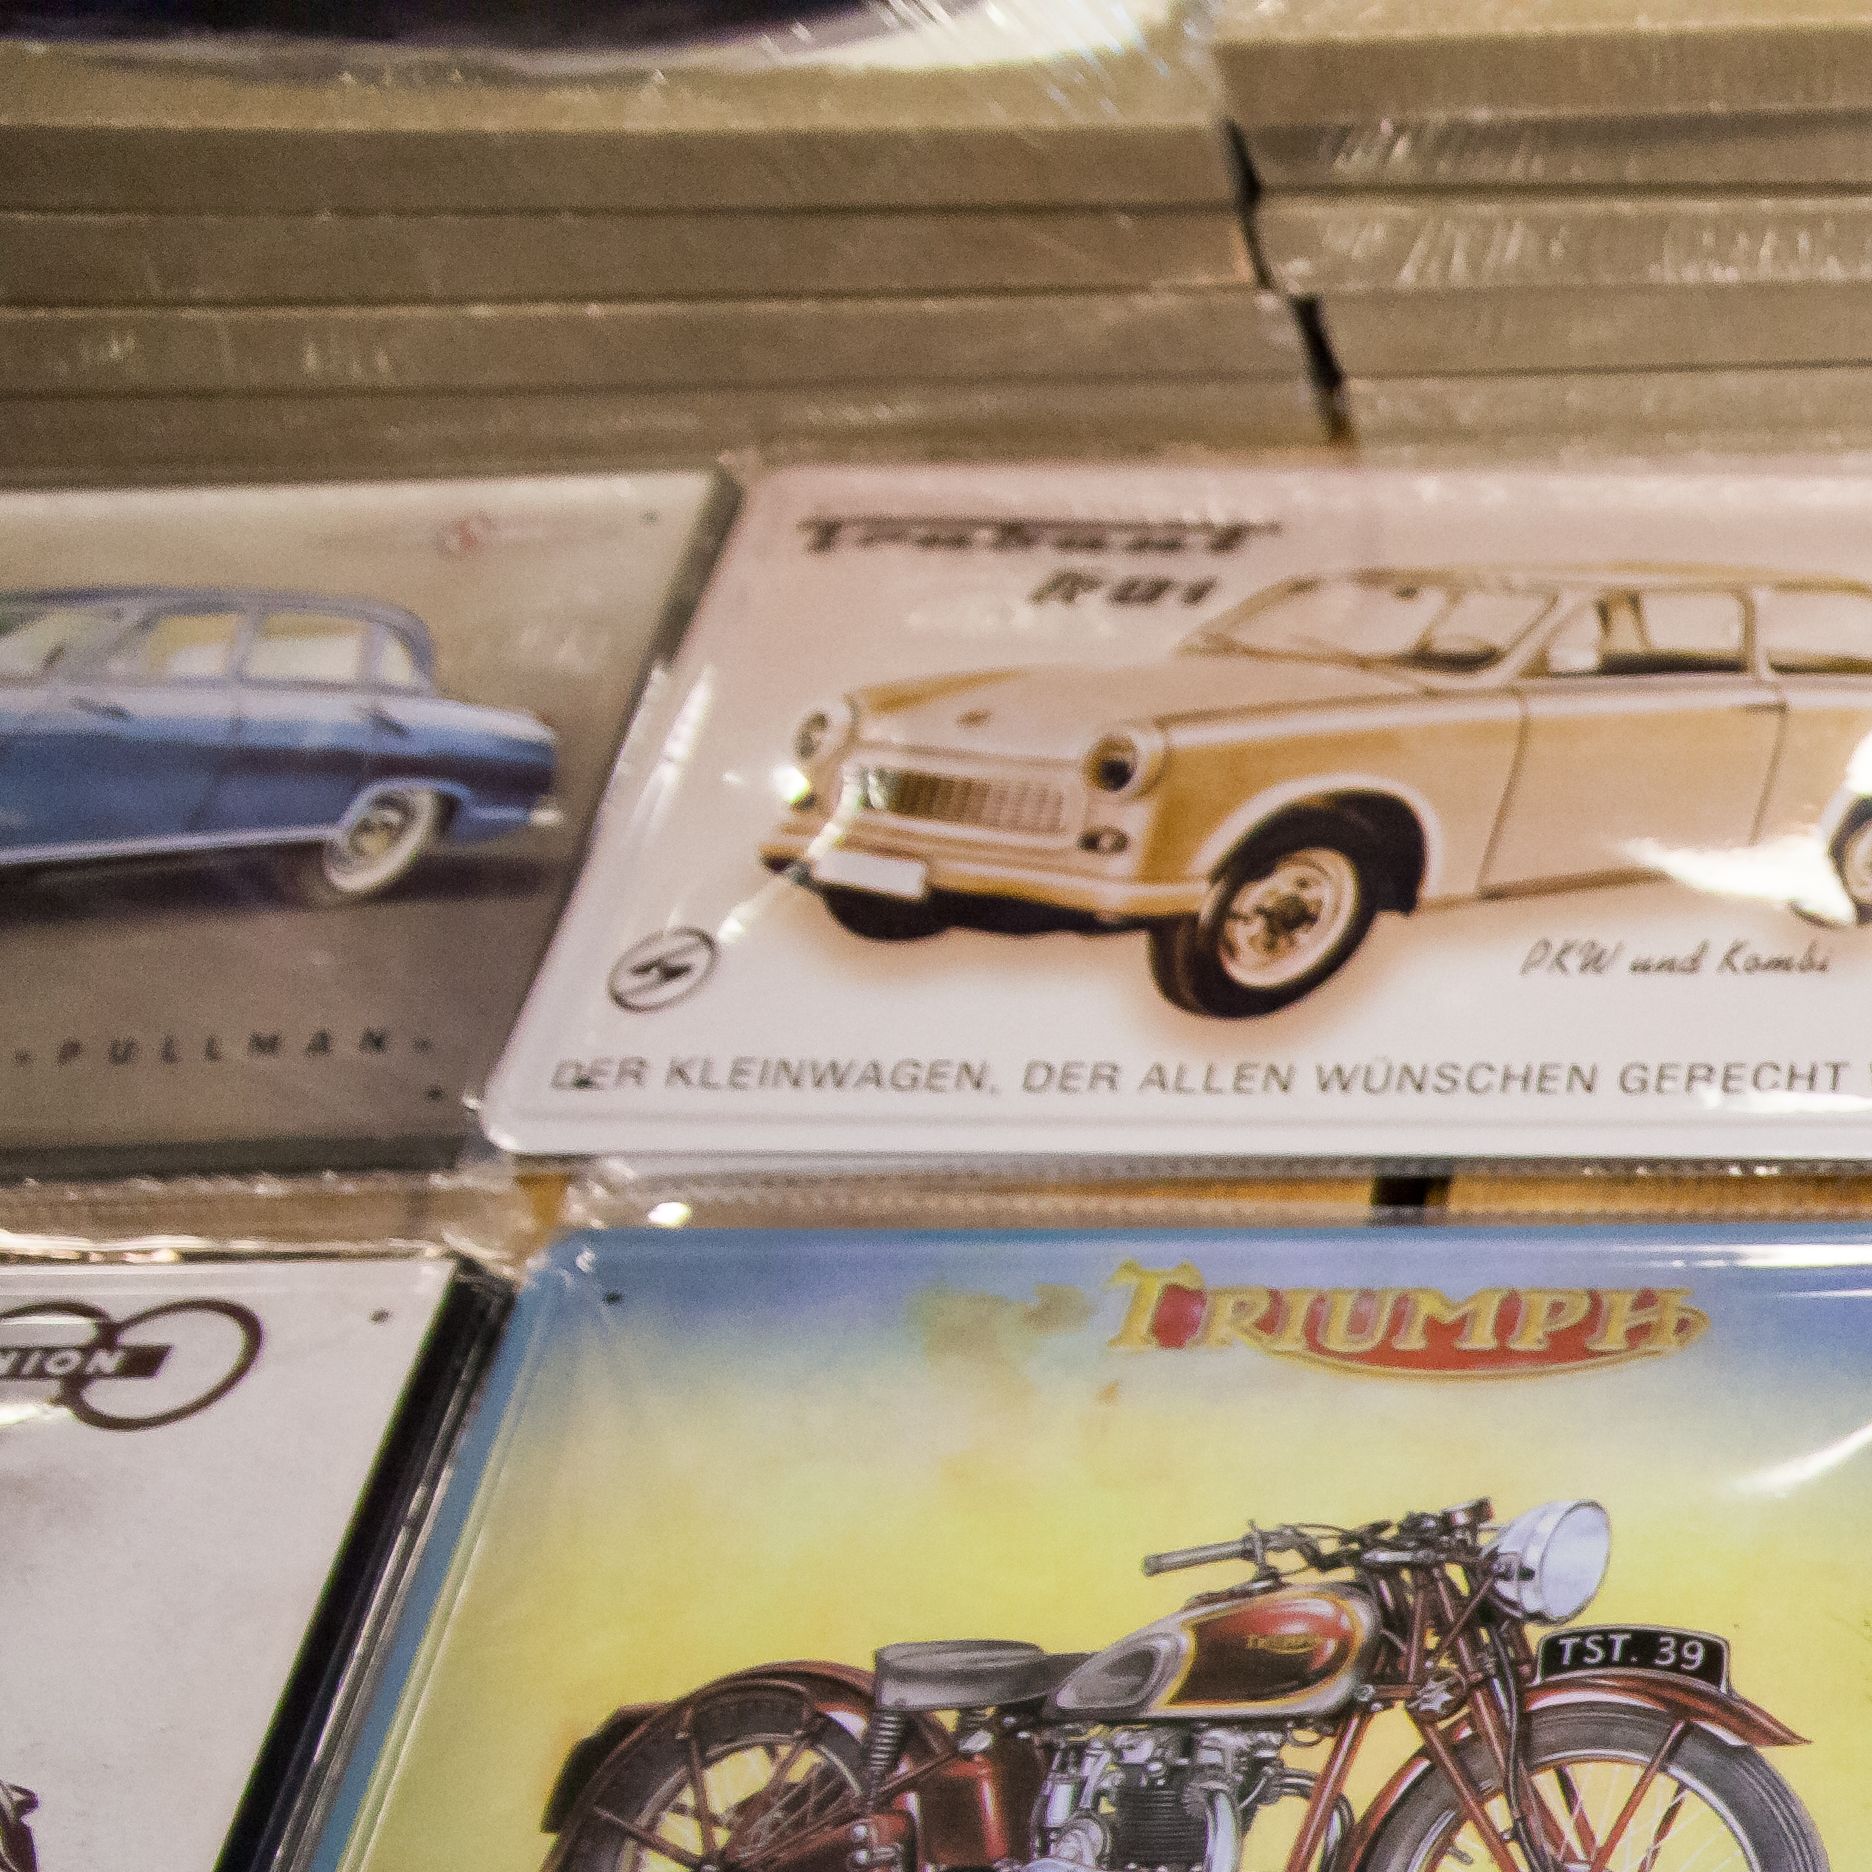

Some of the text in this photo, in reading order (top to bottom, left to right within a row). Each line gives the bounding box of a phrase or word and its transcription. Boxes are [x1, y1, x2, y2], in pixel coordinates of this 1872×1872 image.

[550, 1055, 648, 1092] DER
[1021, 1058, 1121, 1094] DER
[1139, 1058, 1297, 1096] ALLEN
[1315, 1053, 1600, 1097] WÜNSCHEN
[1617, 1060, 1852, 1096] GERECHT
[1108, 1259, 1706, 1352] TRIUMPH
[1558, 1634, 1705, 1673] TST. 39
